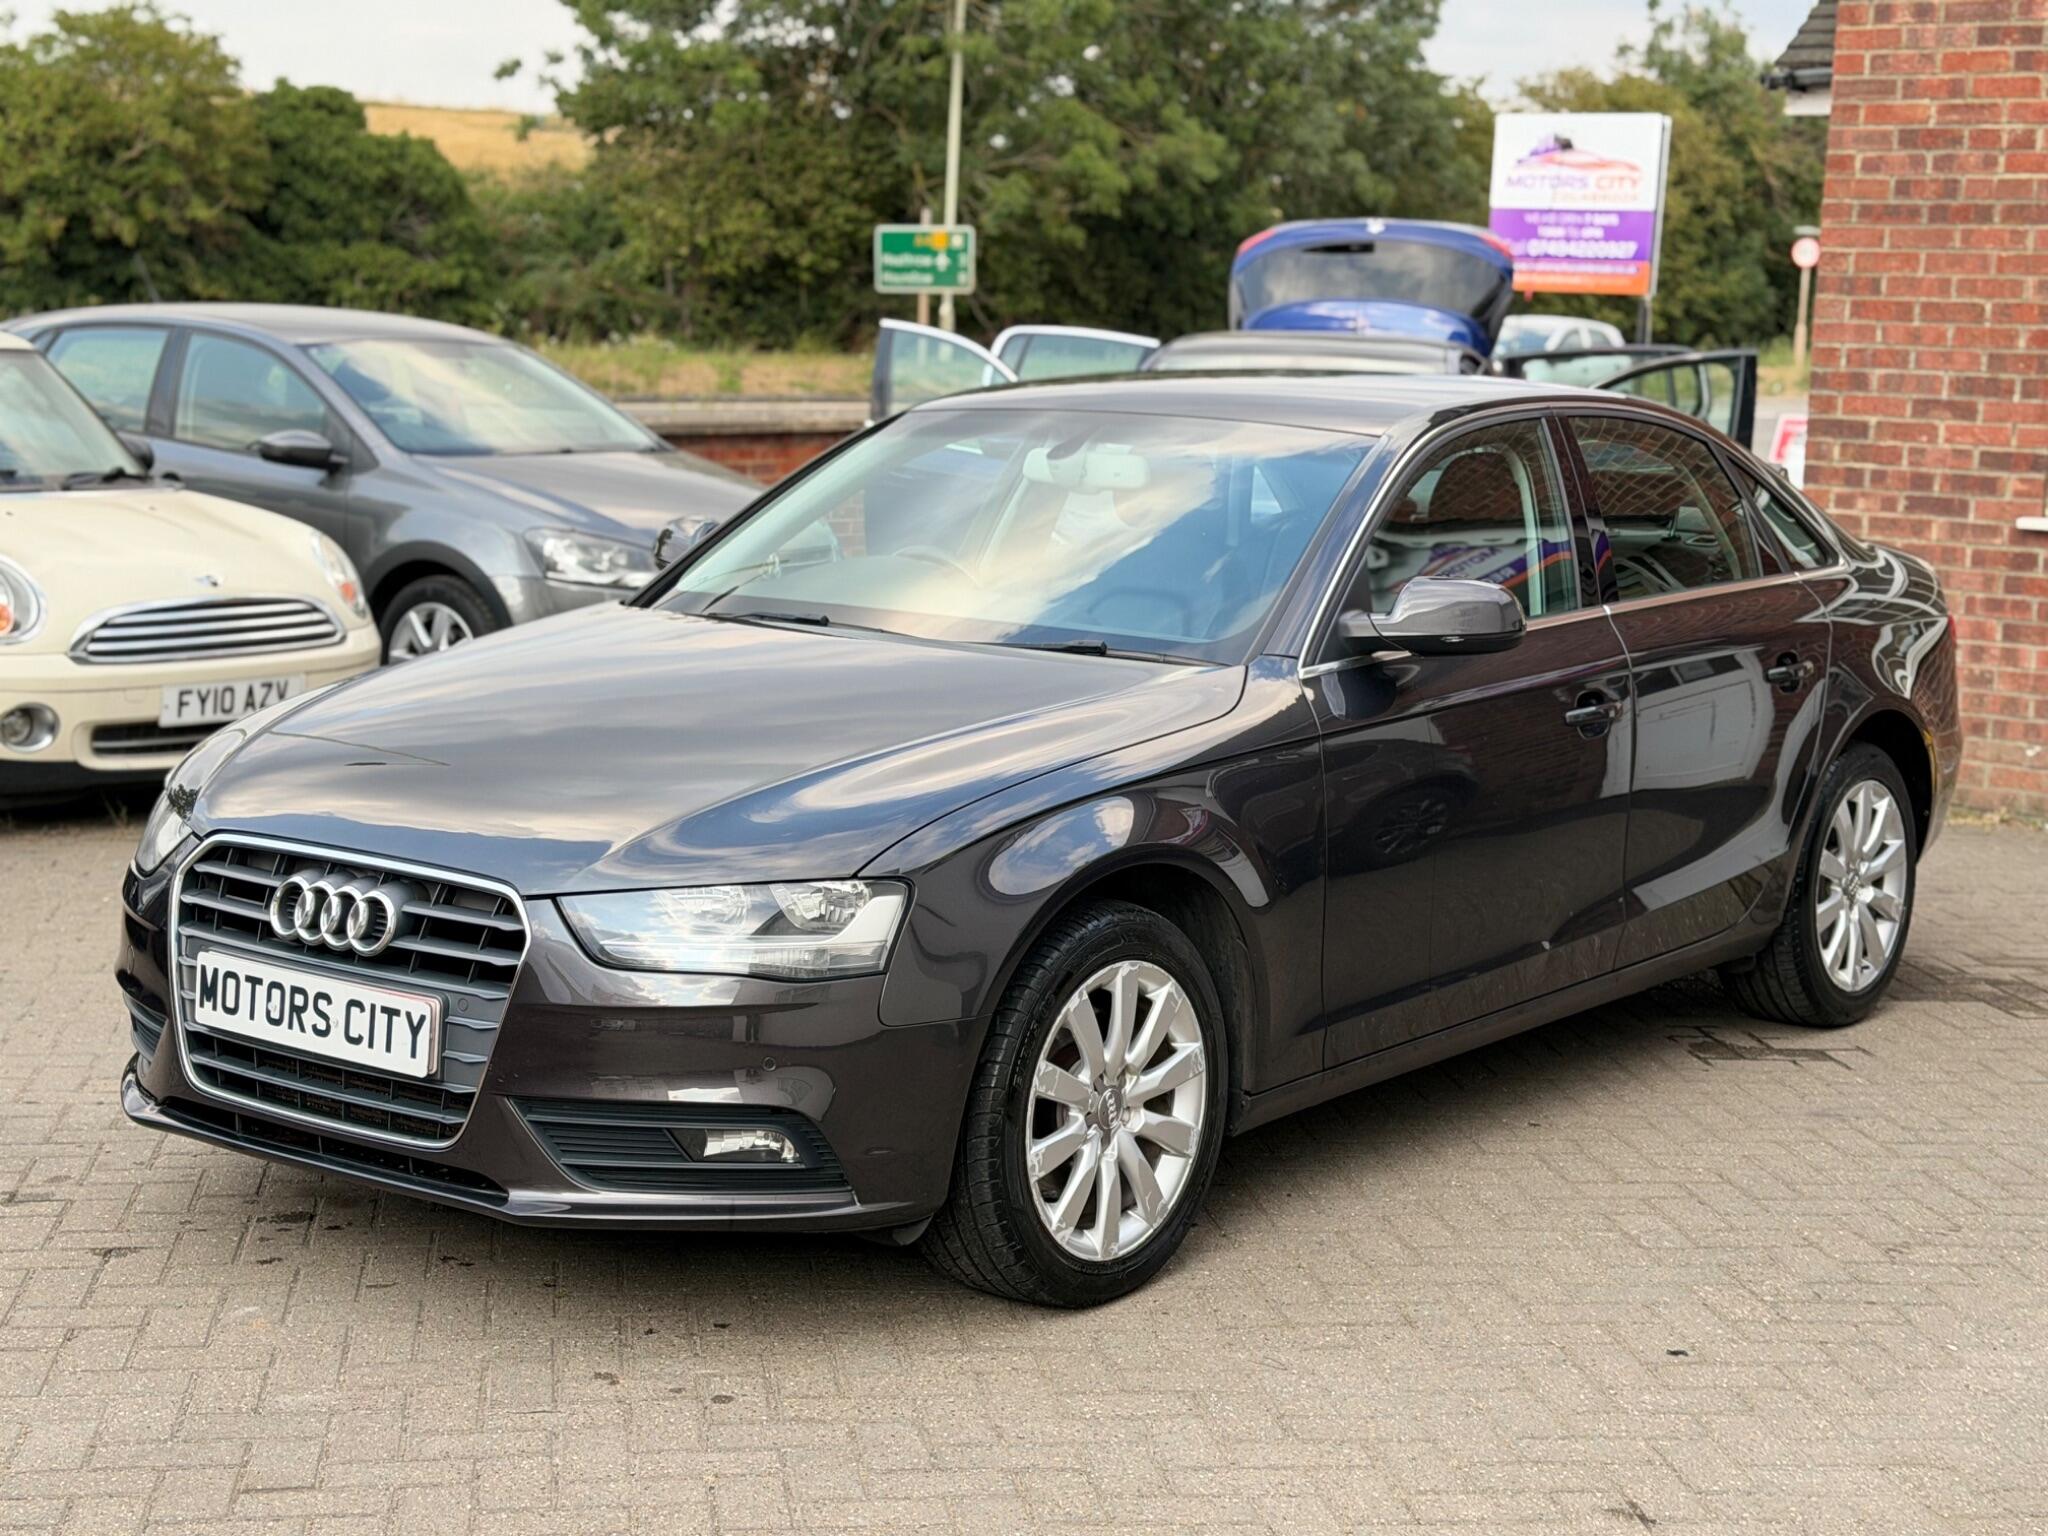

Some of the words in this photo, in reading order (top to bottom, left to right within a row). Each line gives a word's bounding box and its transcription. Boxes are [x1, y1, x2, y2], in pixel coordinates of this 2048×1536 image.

[1504, 174, 1589, 189] MOTORS
[1595, 174, 1639, 189] CITY
[177, 686, 235, 718] FY10
[199, 963, 333, 1038] MOTORS
[343, 998, 427, 1060] CITY
